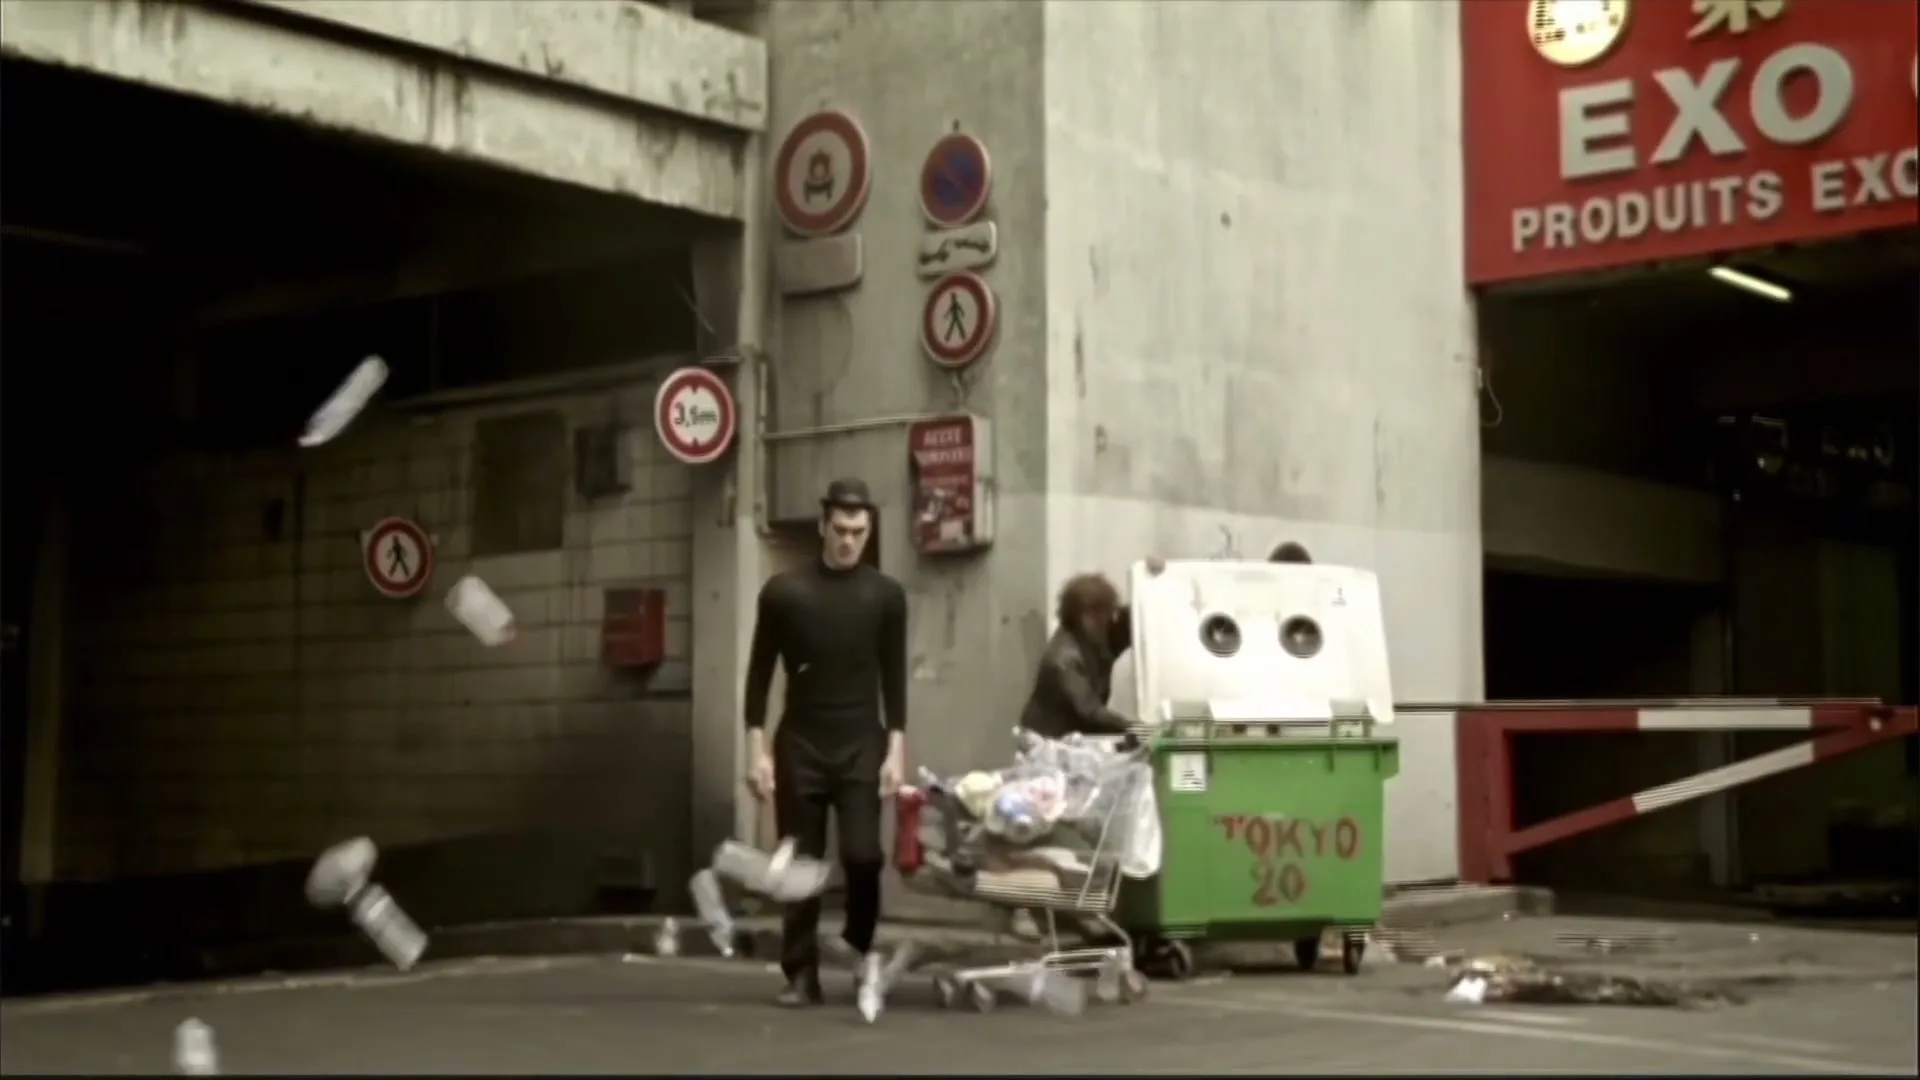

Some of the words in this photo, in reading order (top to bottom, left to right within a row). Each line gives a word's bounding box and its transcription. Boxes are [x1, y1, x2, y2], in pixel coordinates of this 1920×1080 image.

[1559, 43, 1853, 180] EXO
[1512, 171, 1783, 252] PRODUITS
[1213, 815, 1359, 860] TOKYO
[1250, 860, 1306, 905] 20
